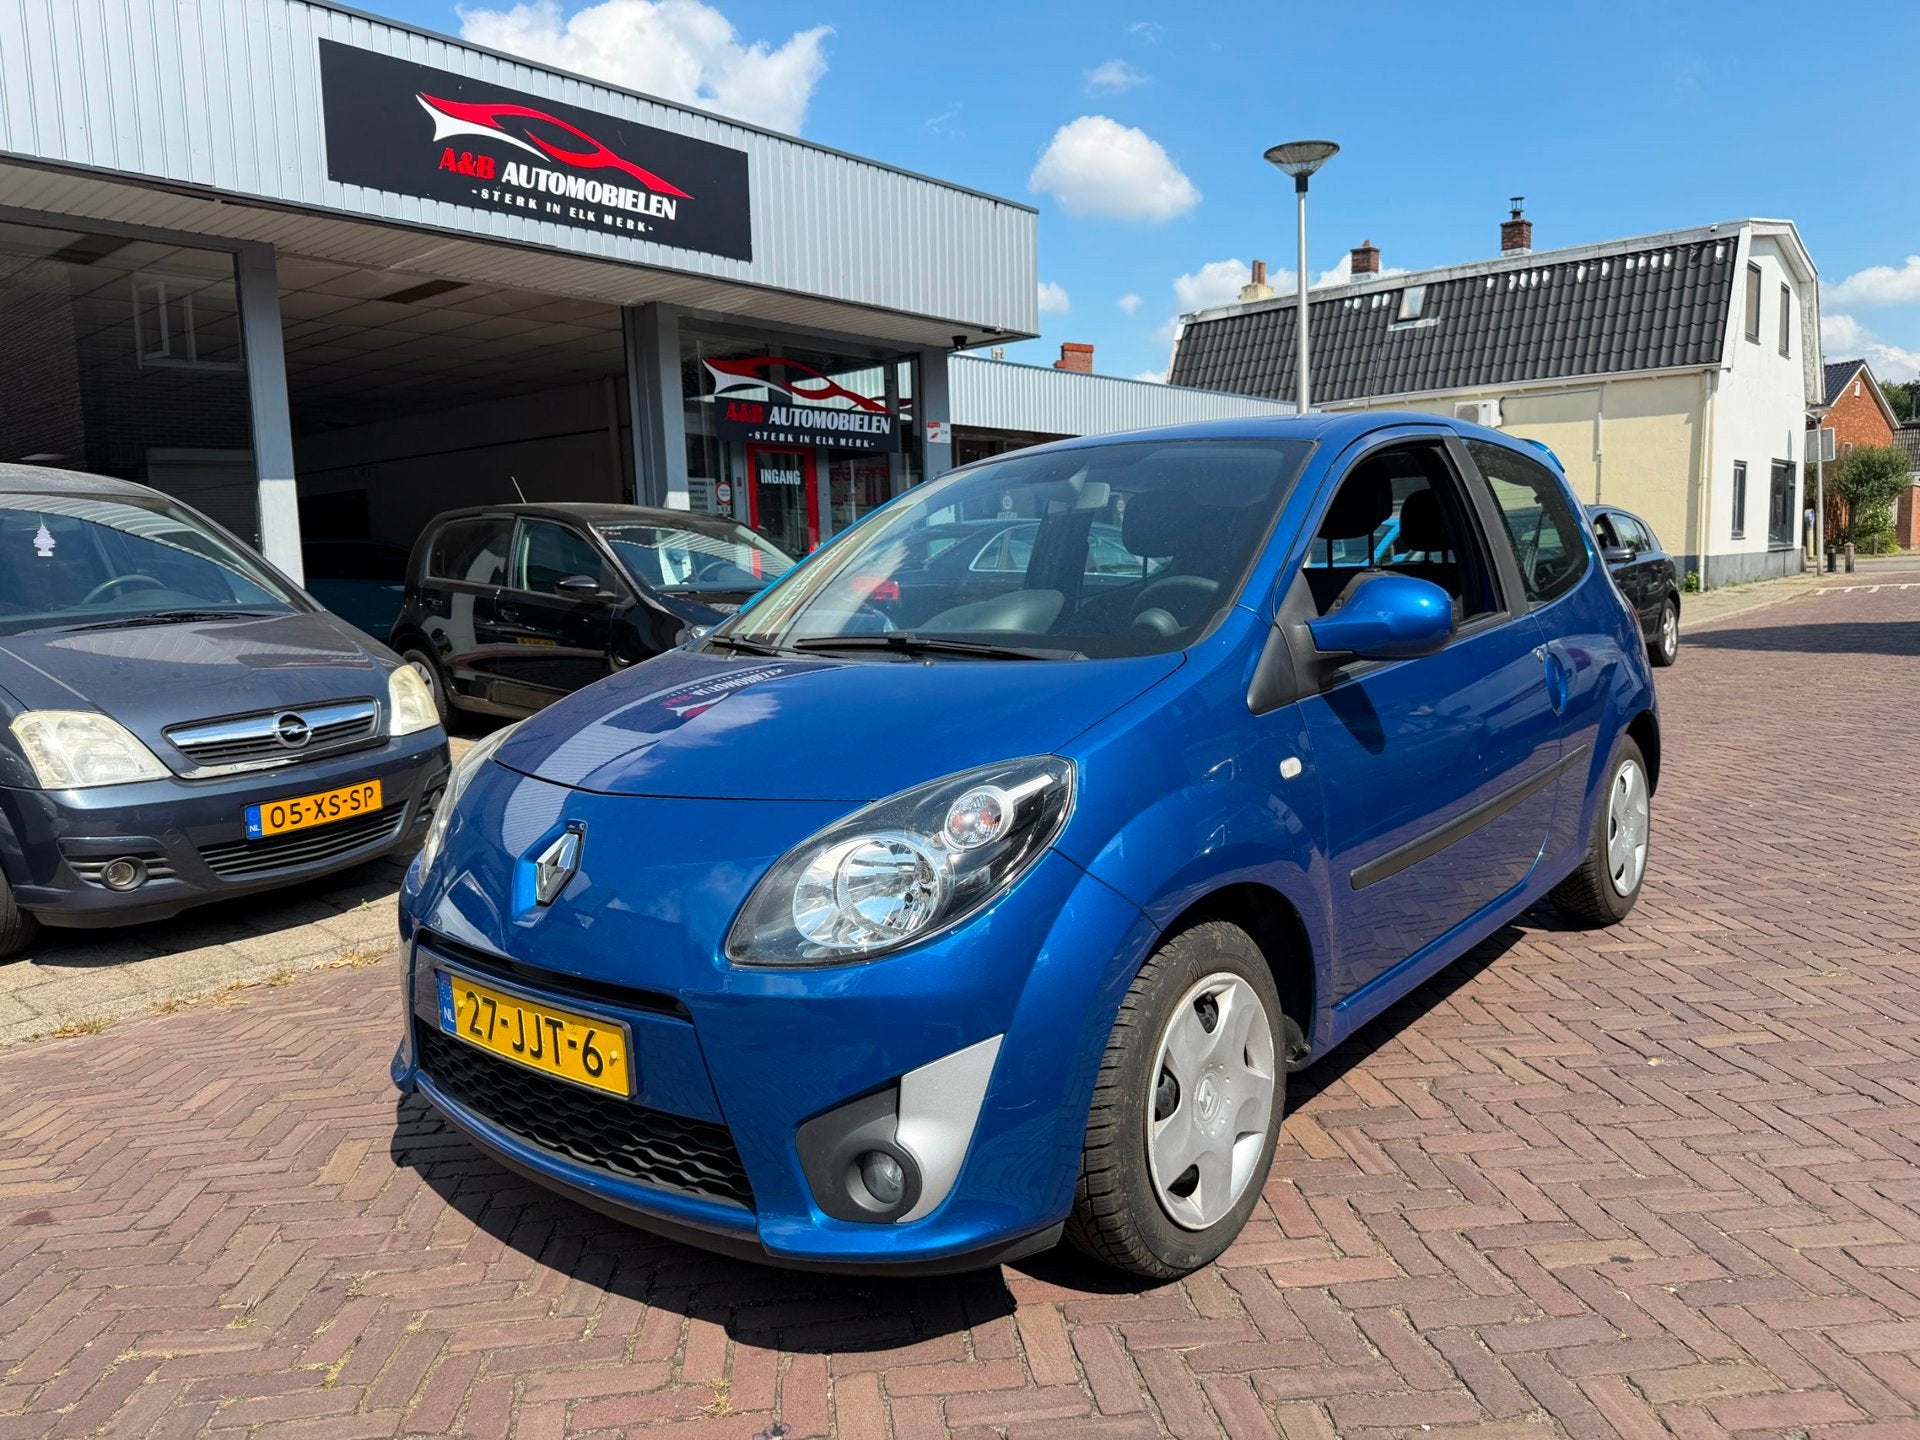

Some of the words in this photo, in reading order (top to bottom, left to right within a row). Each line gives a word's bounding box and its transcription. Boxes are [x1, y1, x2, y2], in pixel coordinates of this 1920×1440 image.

[438, 148, 497, 180] A&B
[501, 161, 678, 220] AUTOMOBIELEN
[546, 202, 561, 215] IN
[569, 206, 596, 222] ELK
[725, 401, 765, 424] A&B
[768, 406, 891, 435] AUTOMOBIELEN
[800, 434, 811, 444] IN
[816, 435, 835, 446] ELK
[760, 468, 802, 486] INGANG
[249, 824, 261, 833] NL
[270, 786, 374, 829] 05-XS-SP
[443, 1006, 455, 1023] NL
[466, 990, 604, 1078] 27-JJT-6
